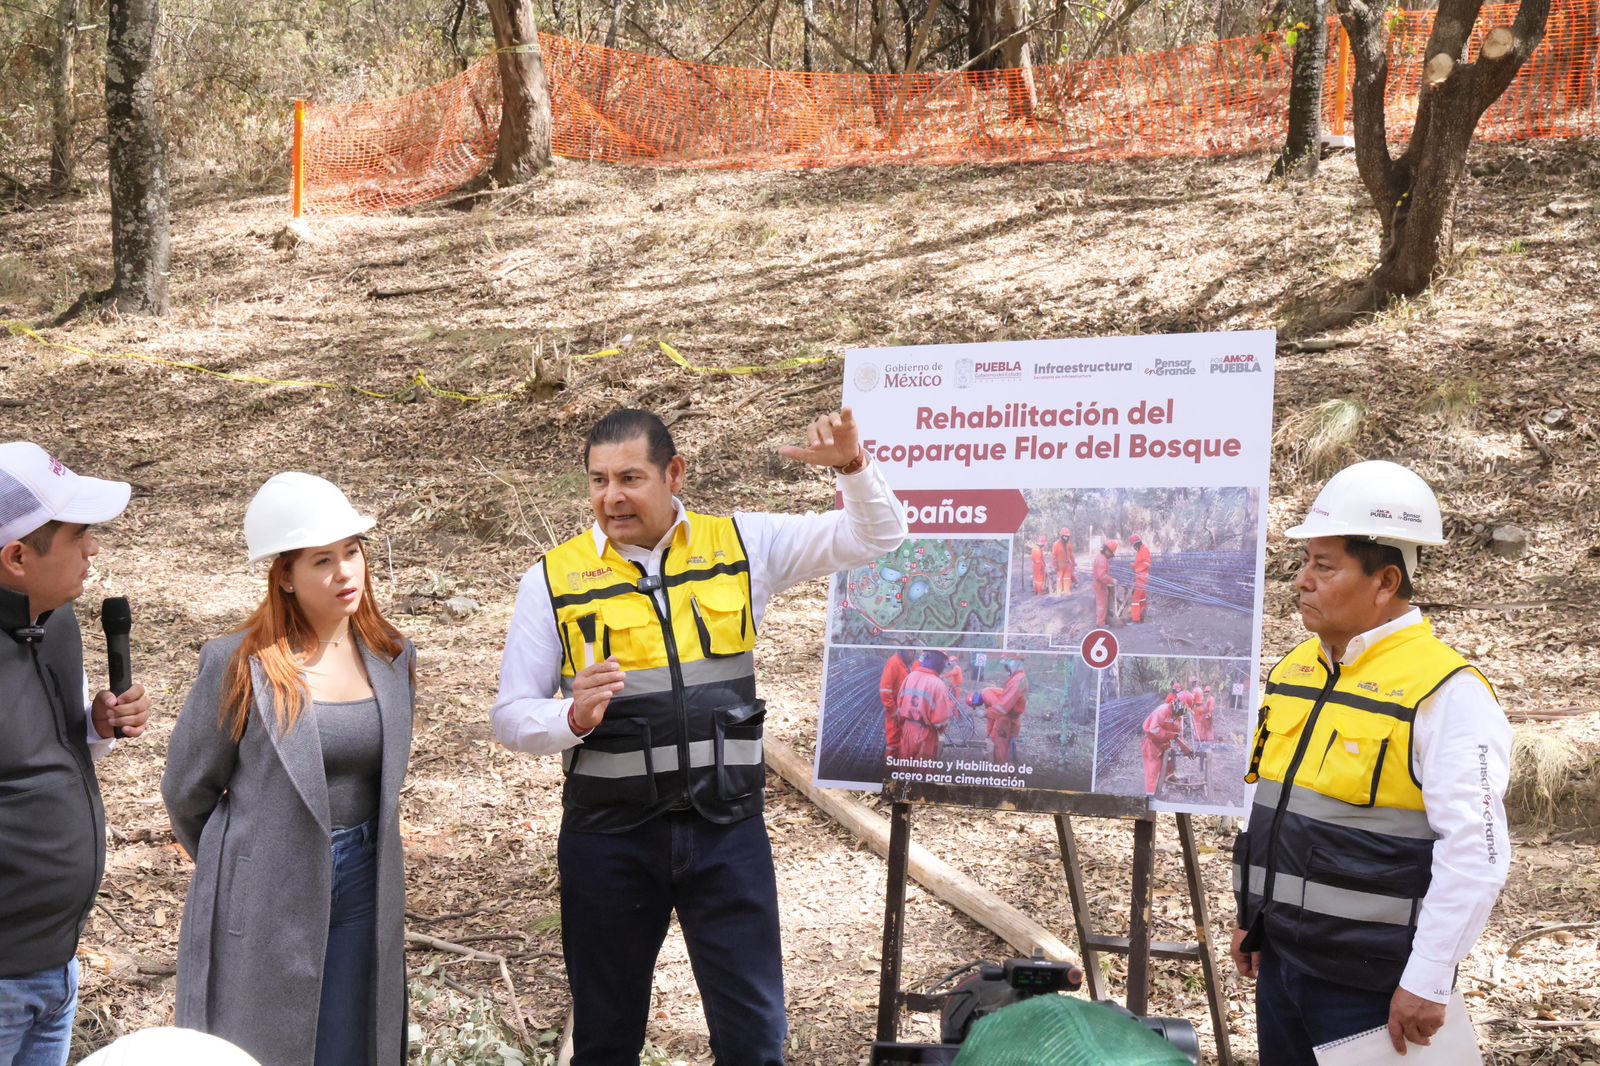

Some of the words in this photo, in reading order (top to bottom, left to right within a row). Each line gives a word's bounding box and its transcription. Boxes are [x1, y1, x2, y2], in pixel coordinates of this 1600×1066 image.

[1154, 358, 1192, 368] Pensar
[1223, 354, 1254, 363] AMOR
[885, 363, 929, 373] Gobierno
[931, 362, 943, 371] de
[975, 361, 1022, 373] PUEBLA
[1034, 361, 1133, 374] Infraestructura
[1156, 365, 1196, 376] Grande
[1210, 362, 1262, 374] PUEBLA
[884, 372, 942, 388] México
[916, 401, 1119, 429] Rehabilitación
[1127, 398, 1174, 425] del
[863, 440, 1006, 468] Ecoparque
[1015, 435, 1068, 460] Flor
[1075, 433, 1120, 459] del
[1129, 434, 1242, 464] Bosque
[902, 499, 988, 524] bañas
[582, 566, 613, 579] PUEBLA
[1091, 637, 1109, 663] 6
[886, 756, 943, 769] Suministro
[946, 761, 953, 772] y
[956, 760, 1015, 774] Habilitado
[1018, 764, 1033, 775] de
[1478, 745, 1491, 791] Pensar
[891, 771, 923, 781] acero
[926, 773, 952, 783] para
[955, 773, 1025, 788] cimentación
[1483, 810, 1498, 865] Grande
